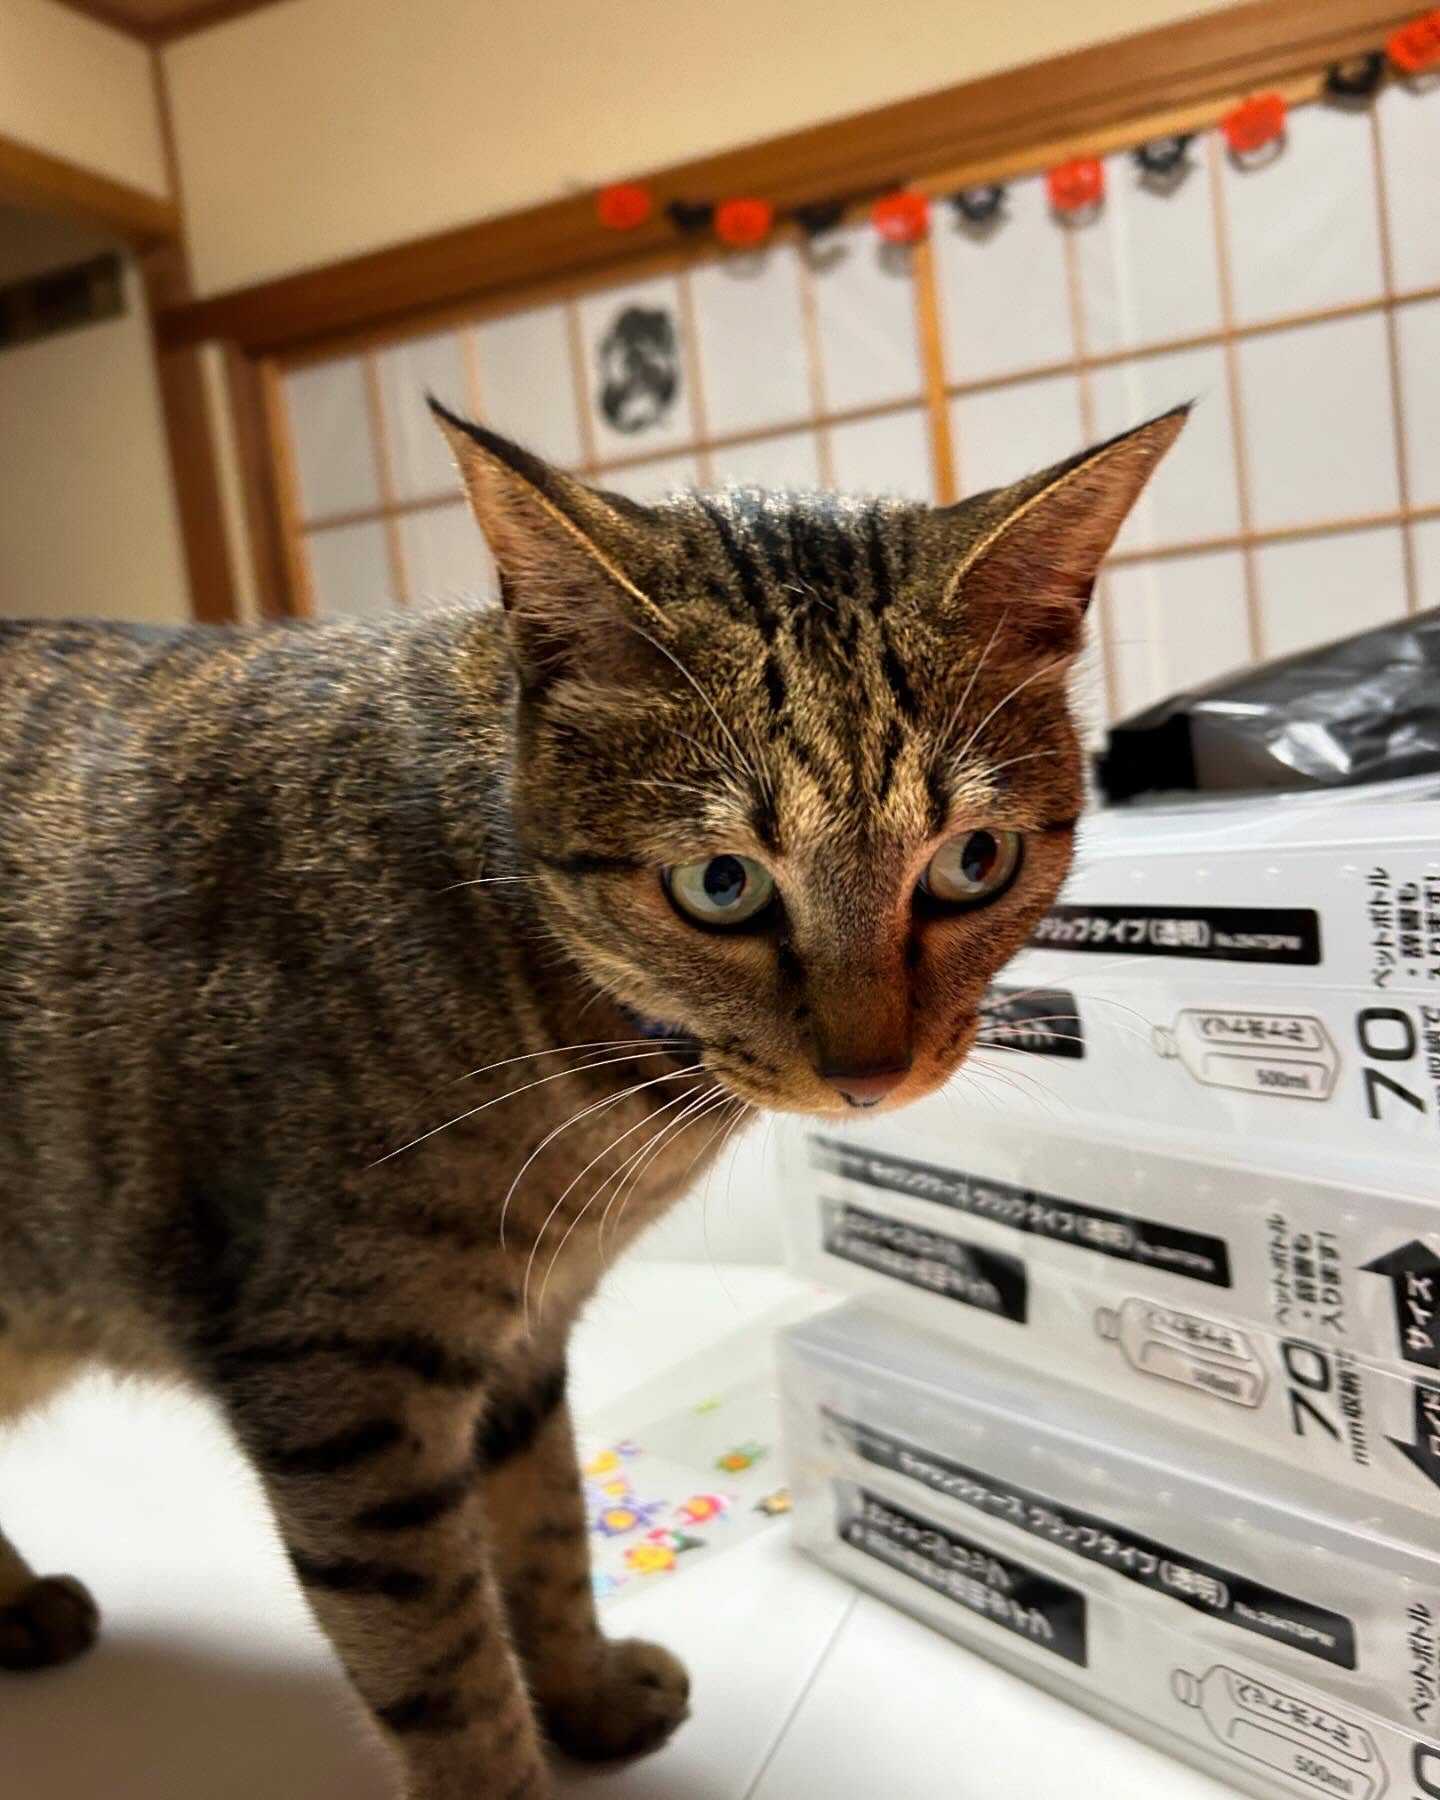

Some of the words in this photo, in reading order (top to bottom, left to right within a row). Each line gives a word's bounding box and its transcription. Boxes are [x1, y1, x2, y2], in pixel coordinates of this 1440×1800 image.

[1367, 866, 1396, 986] ペットボトル
[1257, 1069, 1310, 1089] 500ml
[1357, 1007, 1427, 1119] 70
[1405, 1271, 1434, 1350] サイズ
[1281, 1336, 1344, 1442] 70
[1407, 1602, 1436, 1722] ペットボトル
[1295, 1754, 1352, 1794] 500ml
